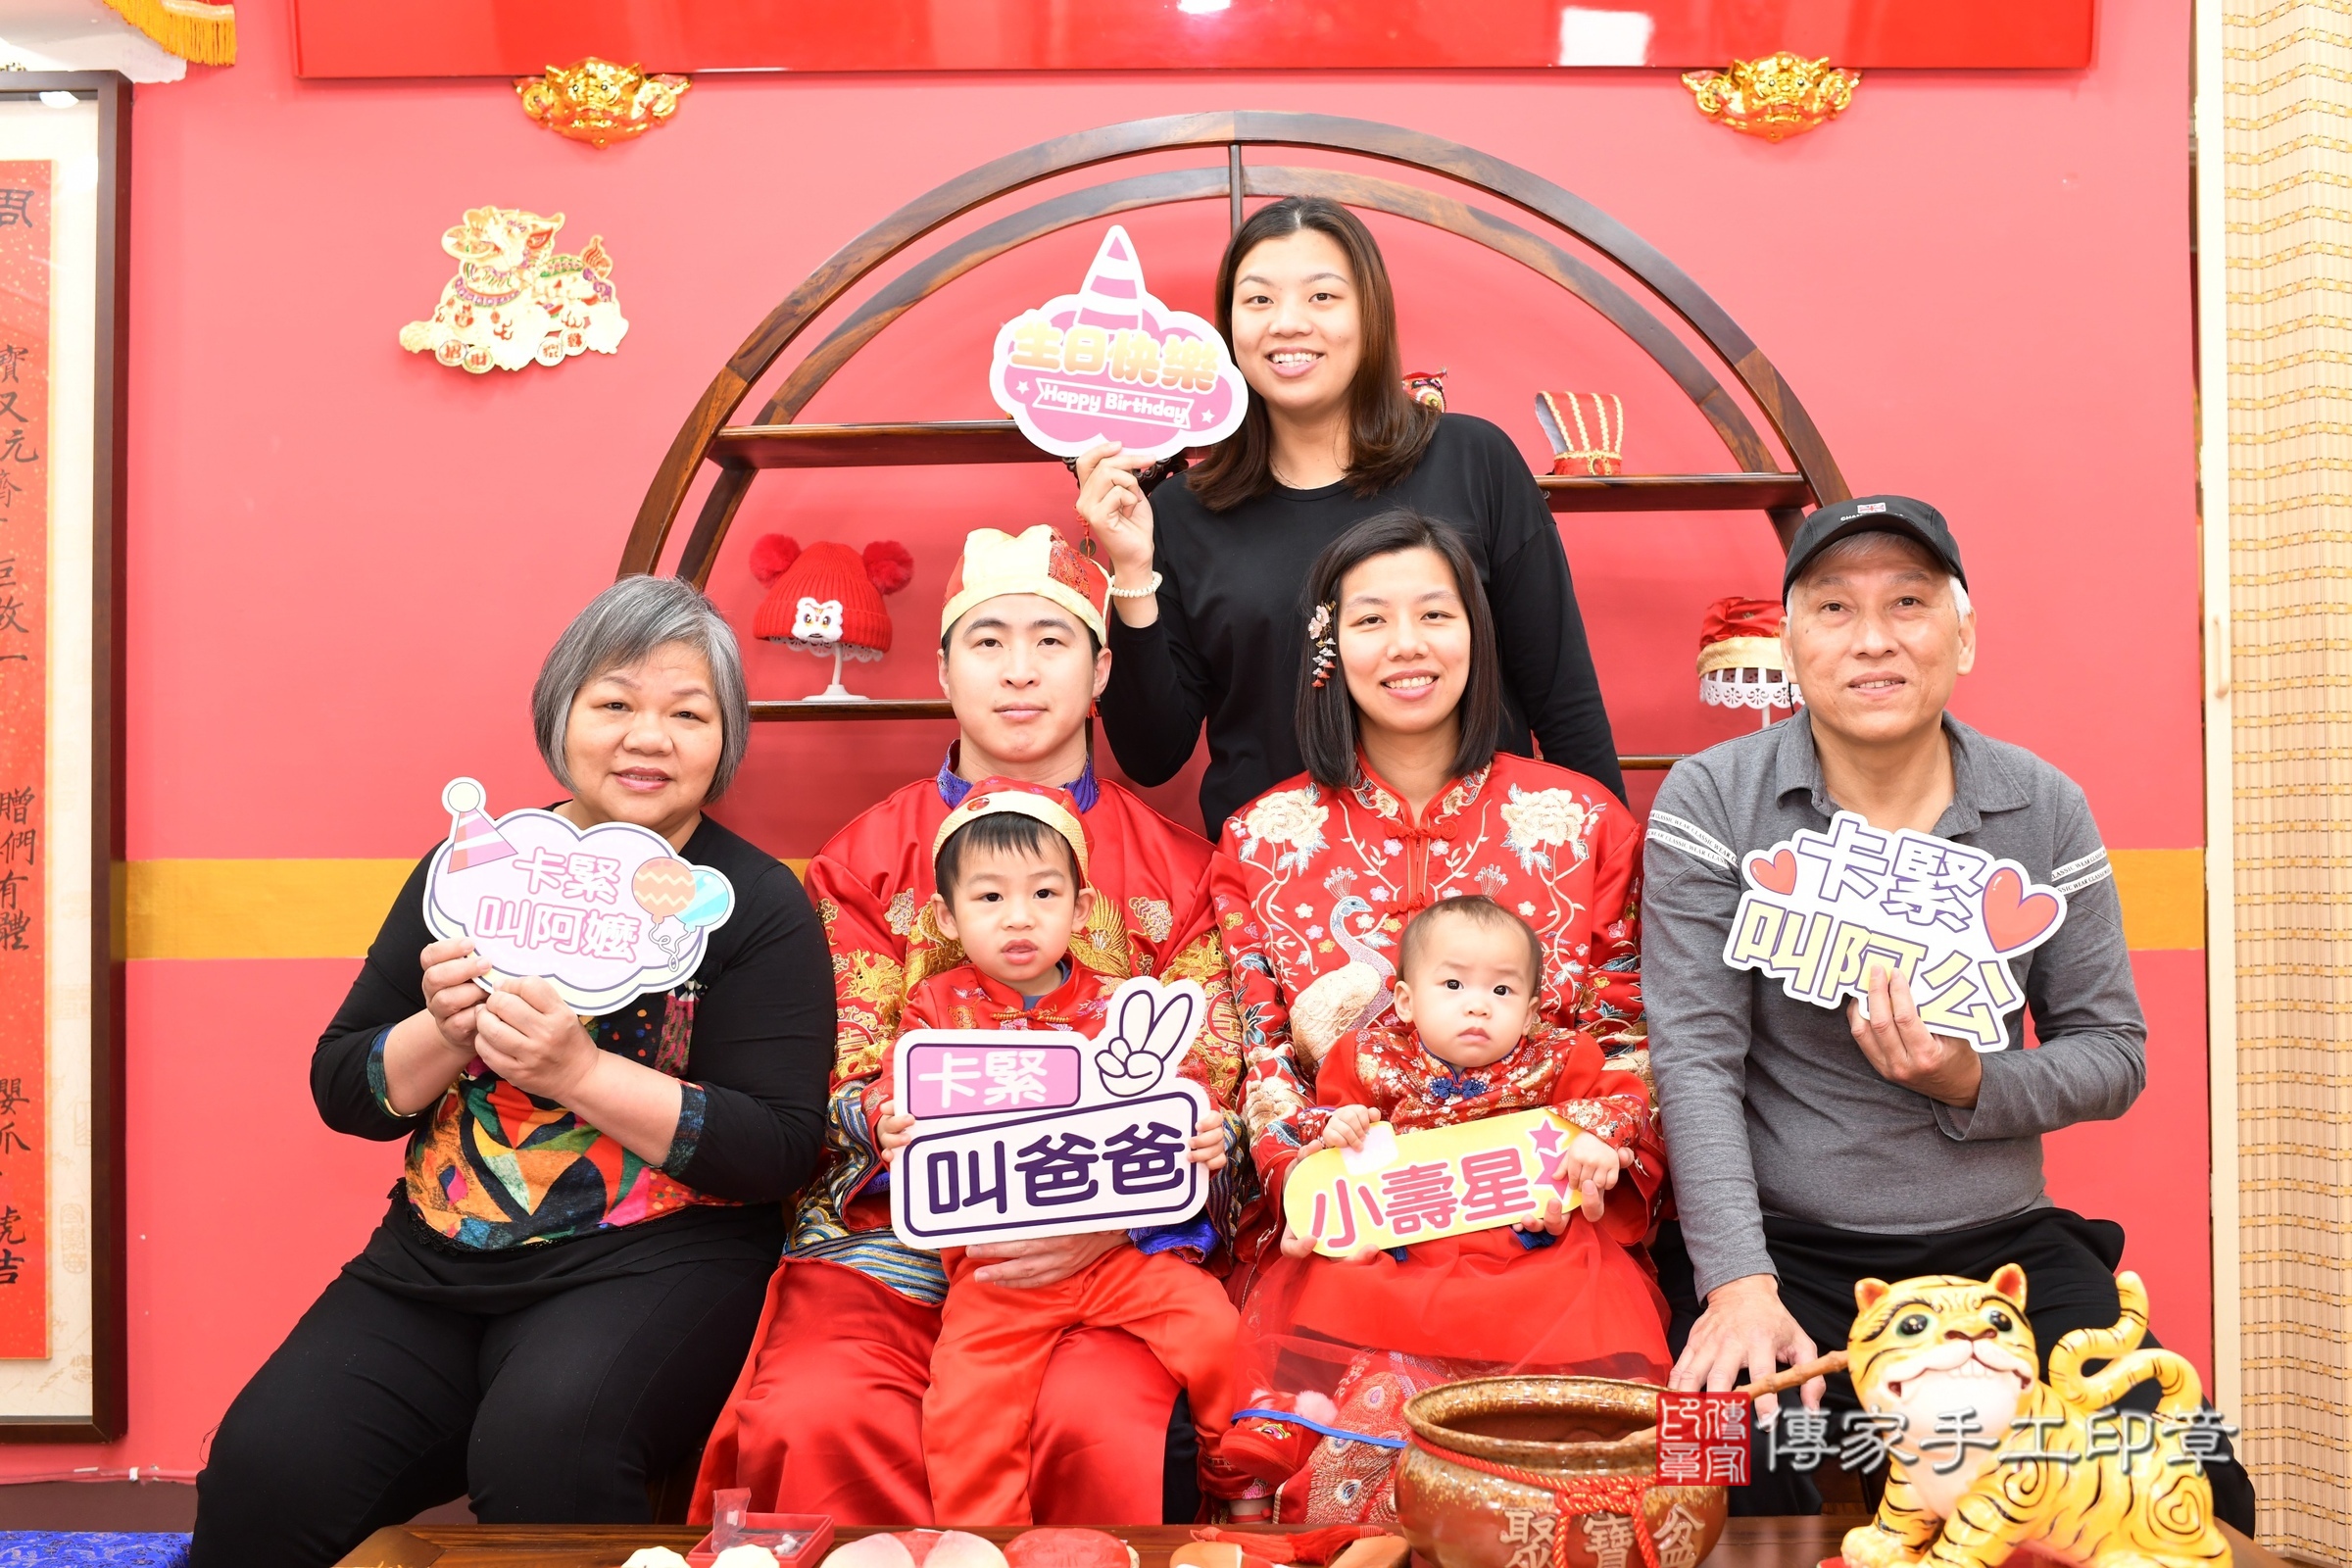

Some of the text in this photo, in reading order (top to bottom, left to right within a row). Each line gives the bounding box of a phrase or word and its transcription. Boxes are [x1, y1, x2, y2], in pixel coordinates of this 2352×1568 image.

[1009, 320, 1220, 393] 生日快樂
[1043, 383, 1189, 424] Happy Birthday
[1689, 845, 1707, 857] WEAR
[1690, 827, 1714, 847] CLASSIC
[1713, 843, 1732, 858] WEAR
[2075, 857, 2091, 869] WEAR
[512, 847, 621, 905] 卡緊
[1796, 818, 1987, 933] 卡緊
[2073, 878, 2088, 890] WEAR
[1731, 899, 2016, 1047] 叫阿公
[917, 1051, 1048, 1109] 卡緊
[926, 1121, 1186, 1215] 叫爸爸
[1311, 1148, 1537, 1250] 小壽星
